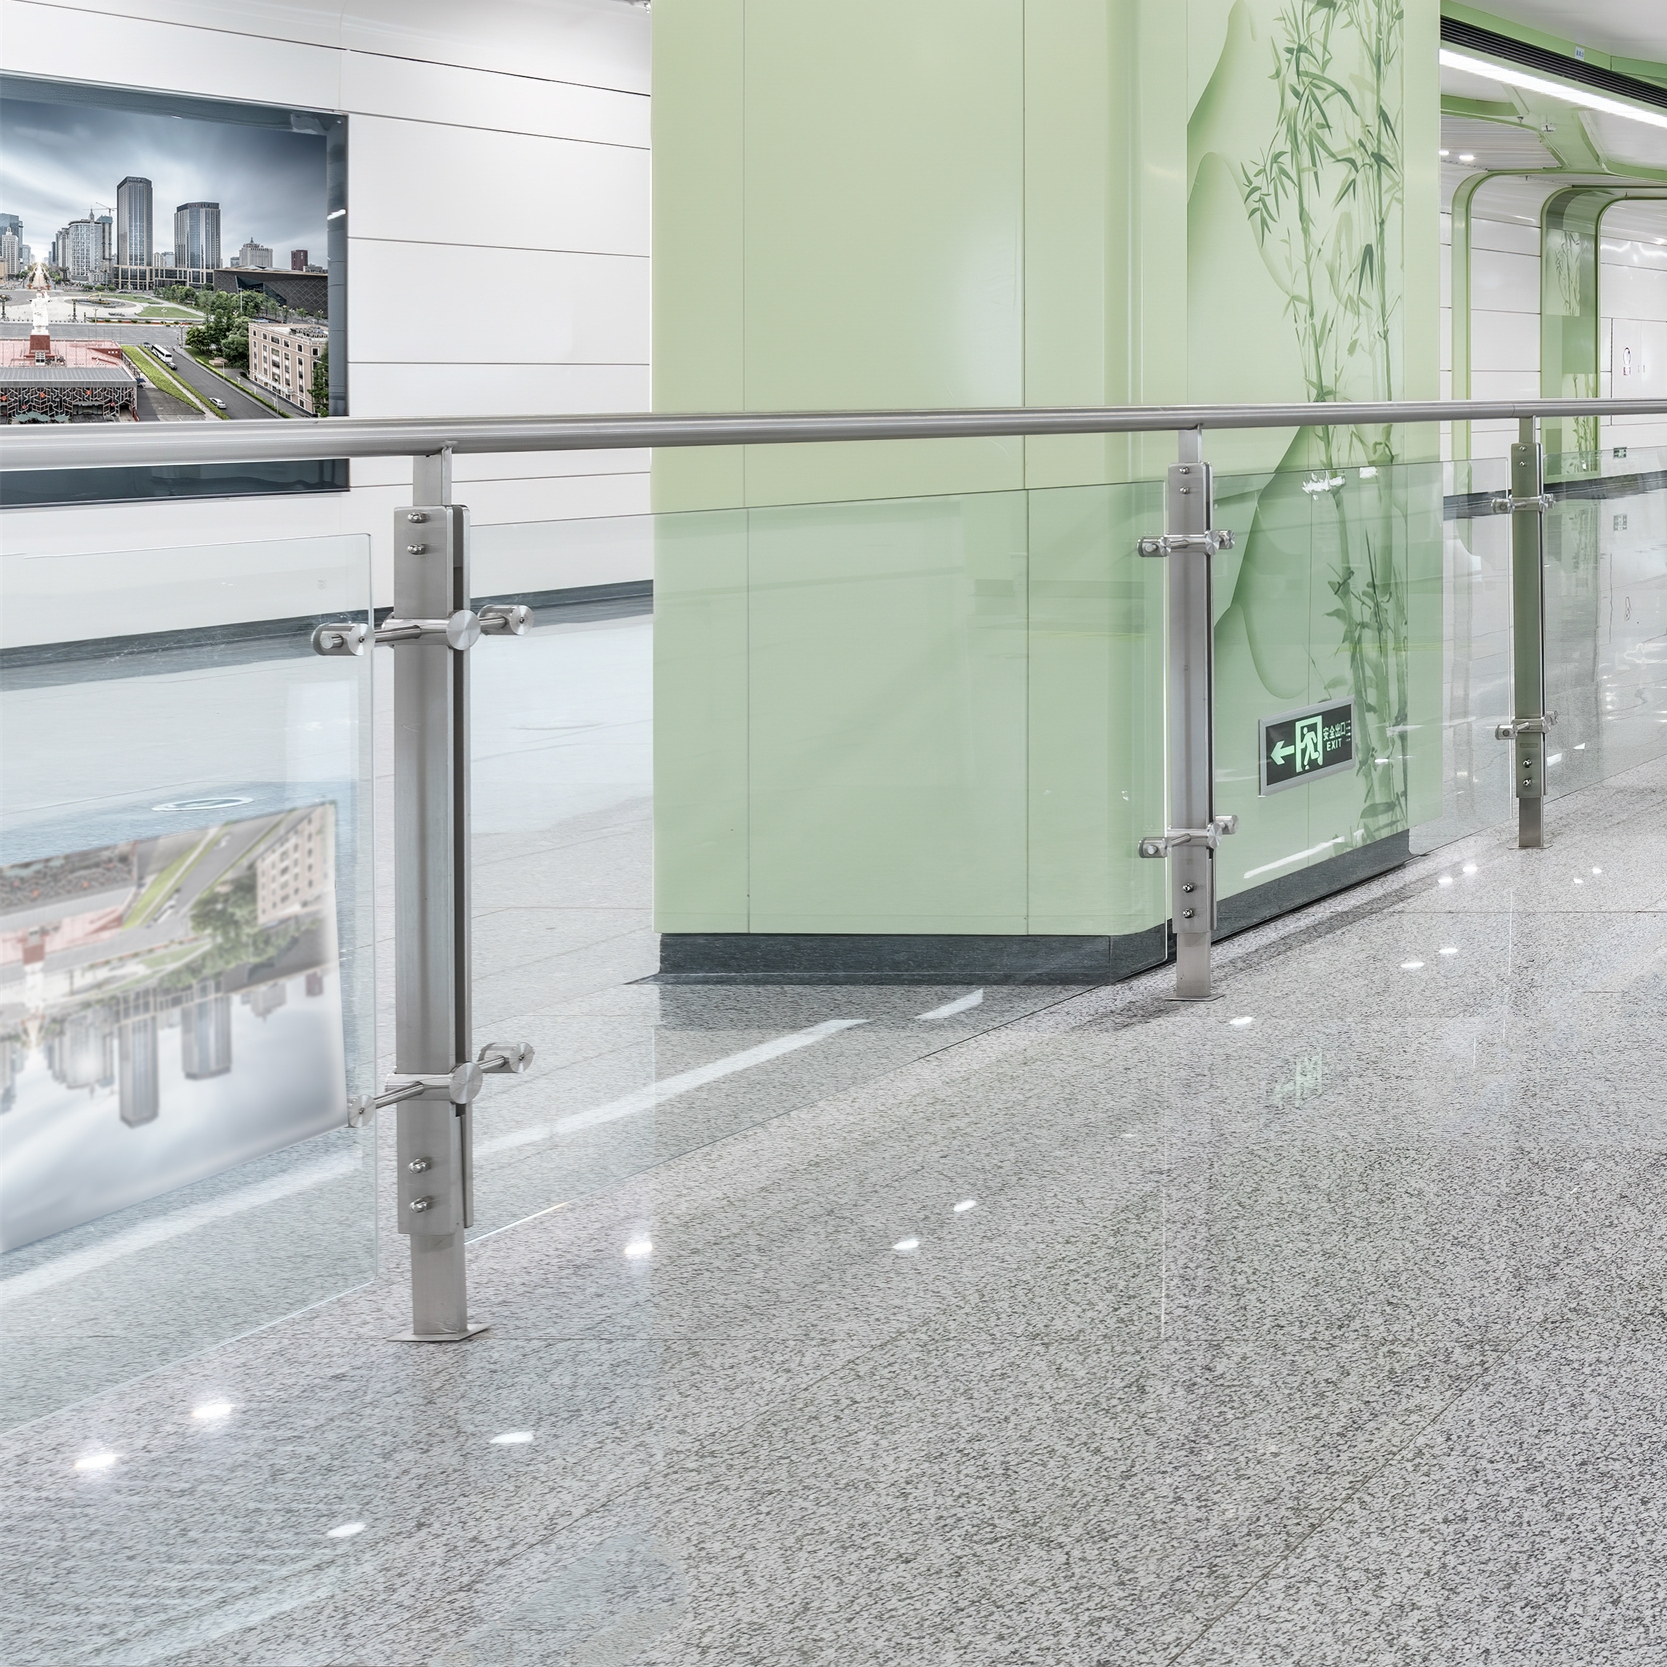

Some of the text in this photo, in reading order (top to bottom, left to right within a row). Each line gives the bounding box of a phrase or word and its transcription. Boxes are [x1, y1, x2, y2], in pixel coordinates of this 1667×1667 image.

[1322, 721, 1346, 741] 安全出口
[1326, 737, 1342, 751] EXIT
